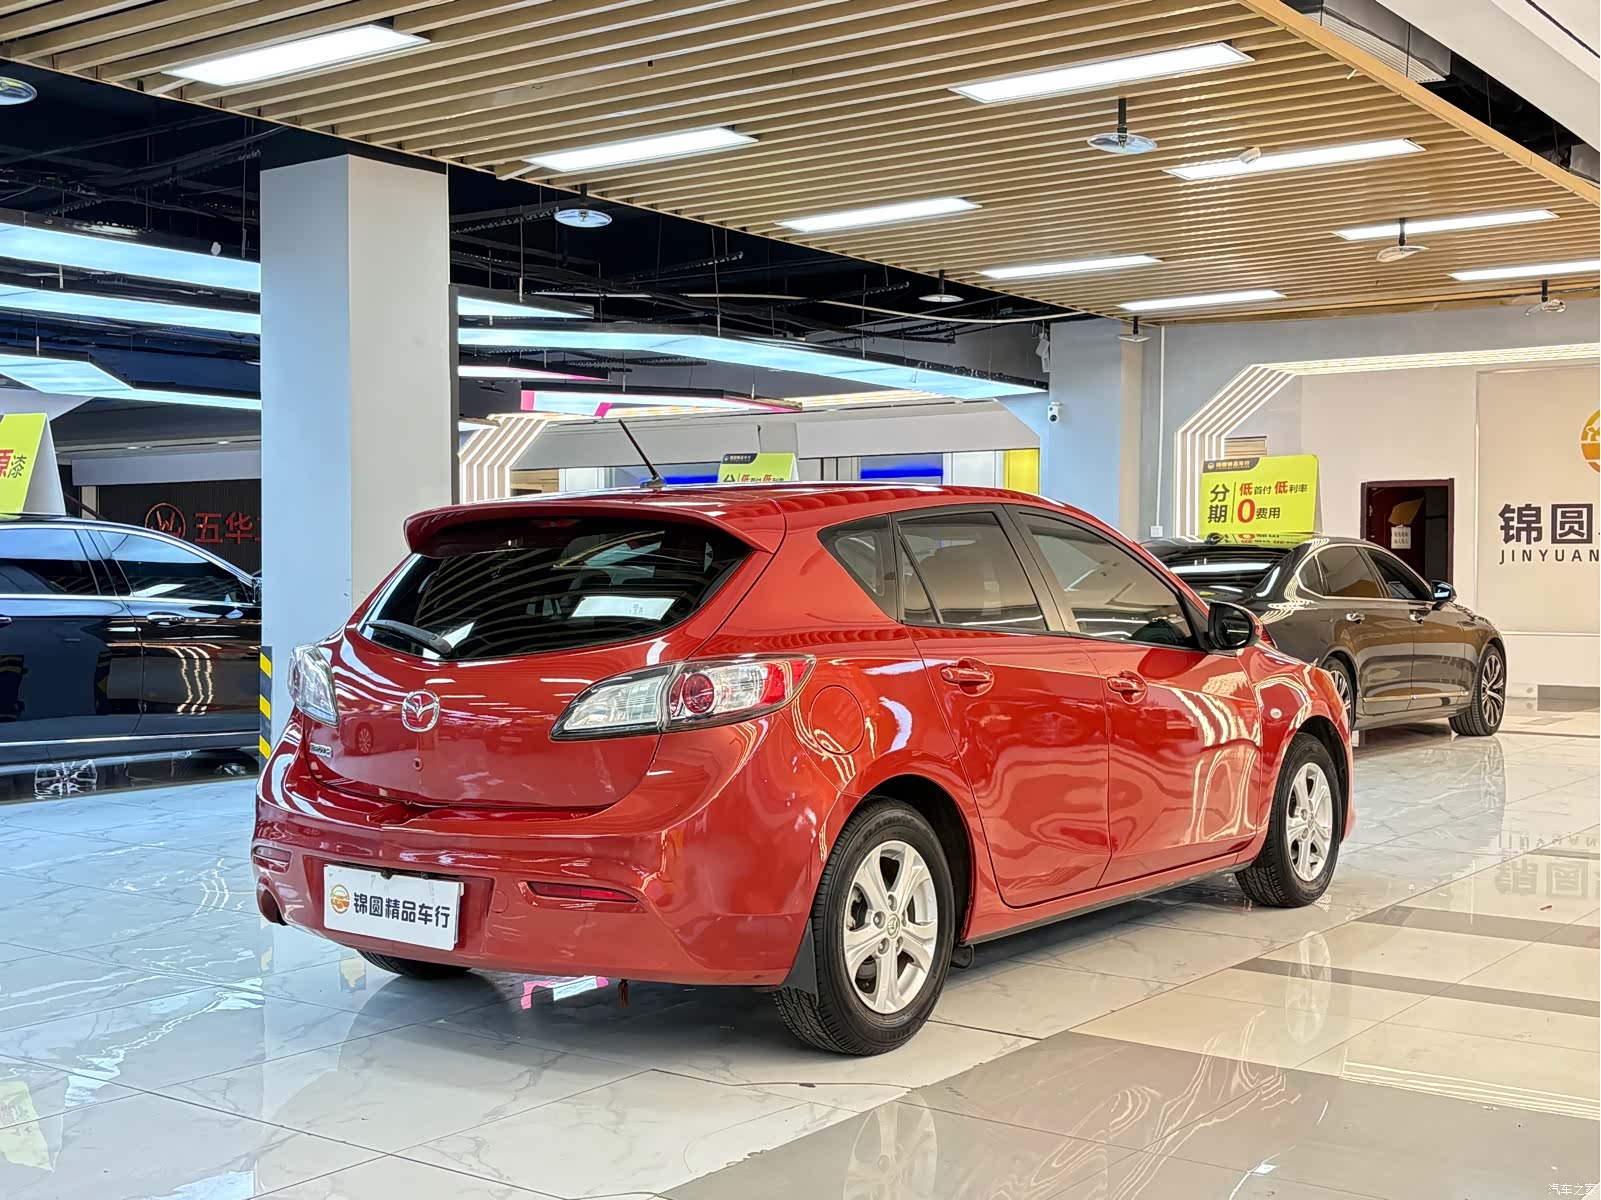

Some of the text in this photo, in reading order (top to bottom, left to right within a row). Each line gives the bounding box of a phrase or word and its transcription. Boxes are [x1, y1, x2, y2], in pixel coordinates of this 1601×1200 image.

[1207, 484, 1230, 524] 分期
[1237, 498, 1281, 523] 0费用
[194, 512, 262, 545] 五华
[1499, 549, 1600, 565] JINYUAN
[353, 892, 451, 928] 锦圆精品车行
